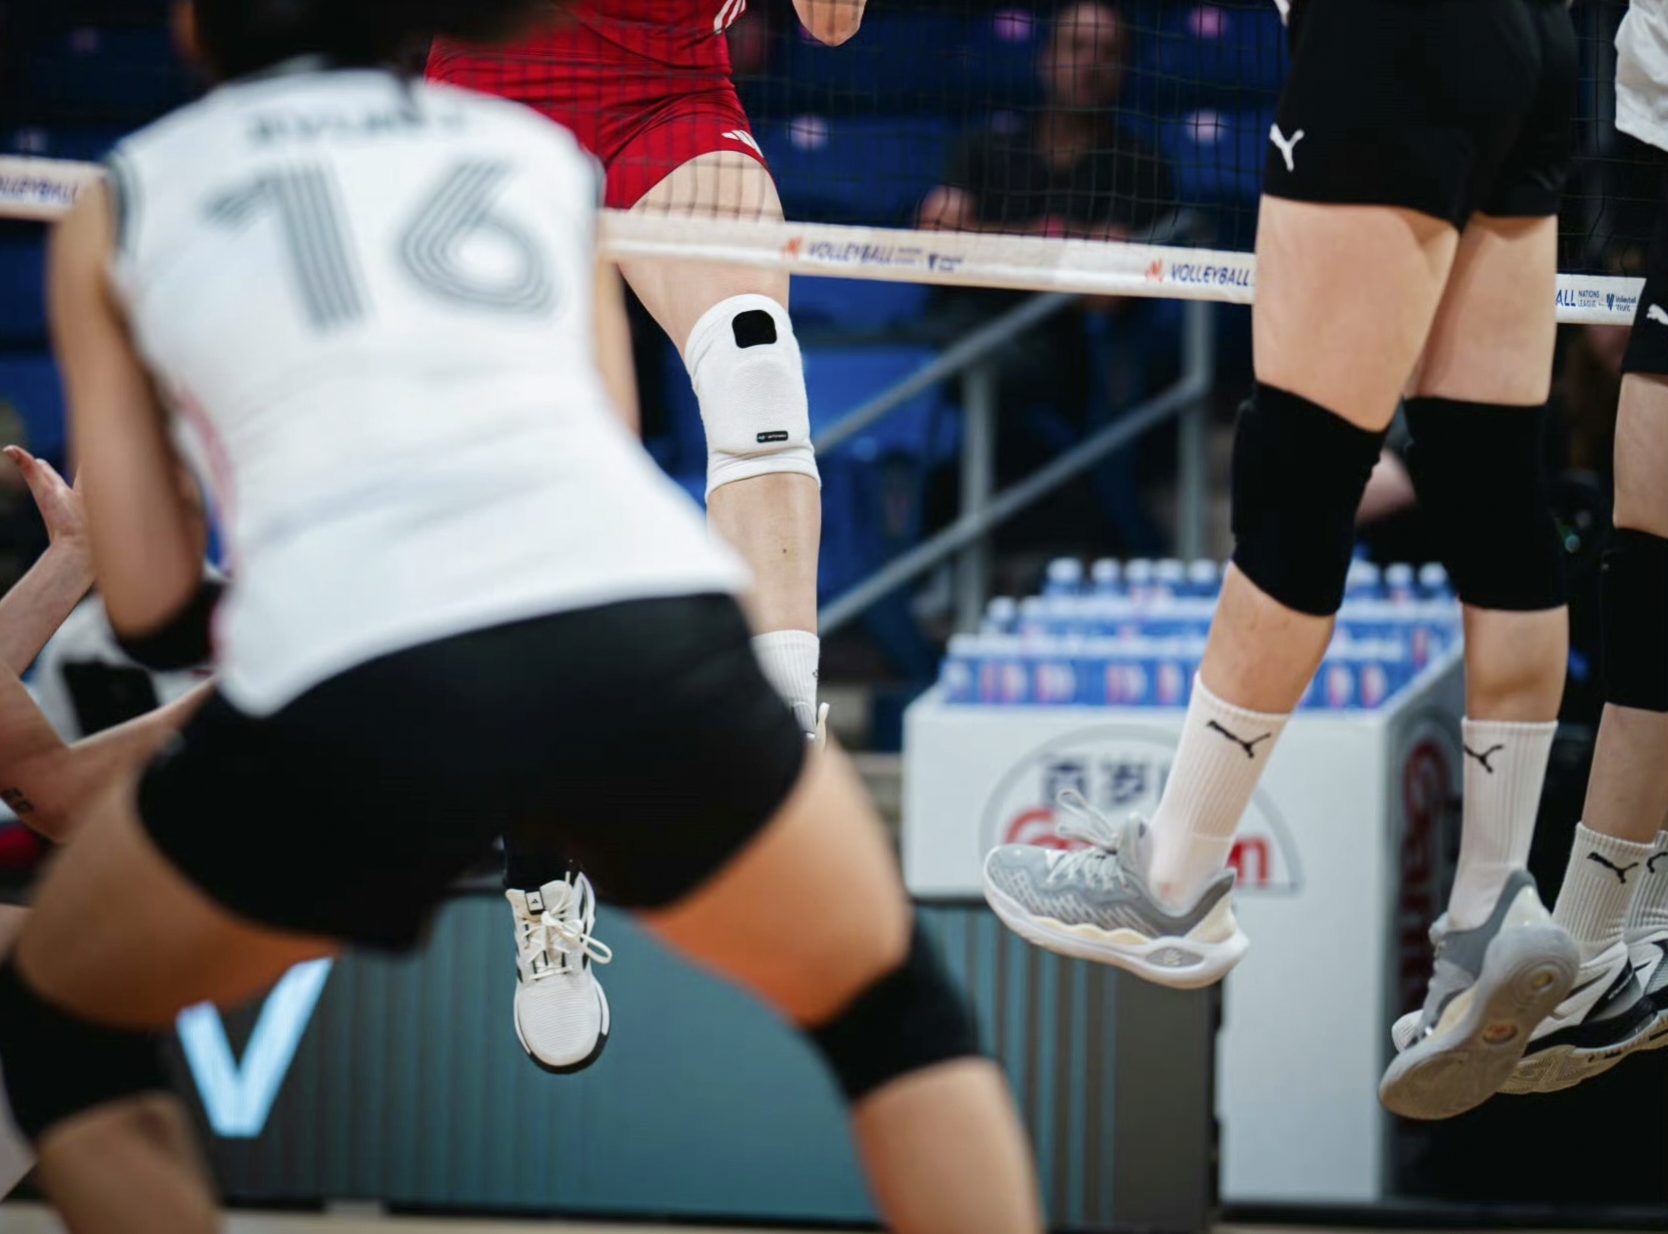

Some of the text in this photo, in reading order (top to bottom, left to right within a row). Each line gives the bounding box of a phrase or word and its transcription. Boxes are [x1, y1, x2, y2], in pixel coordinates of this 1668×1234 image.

[200, 158, 562, 332] 16
[1170, 263, 1250, 287] VOLLEYBALL
[1578, 289, 1600, 298] NATIONS
